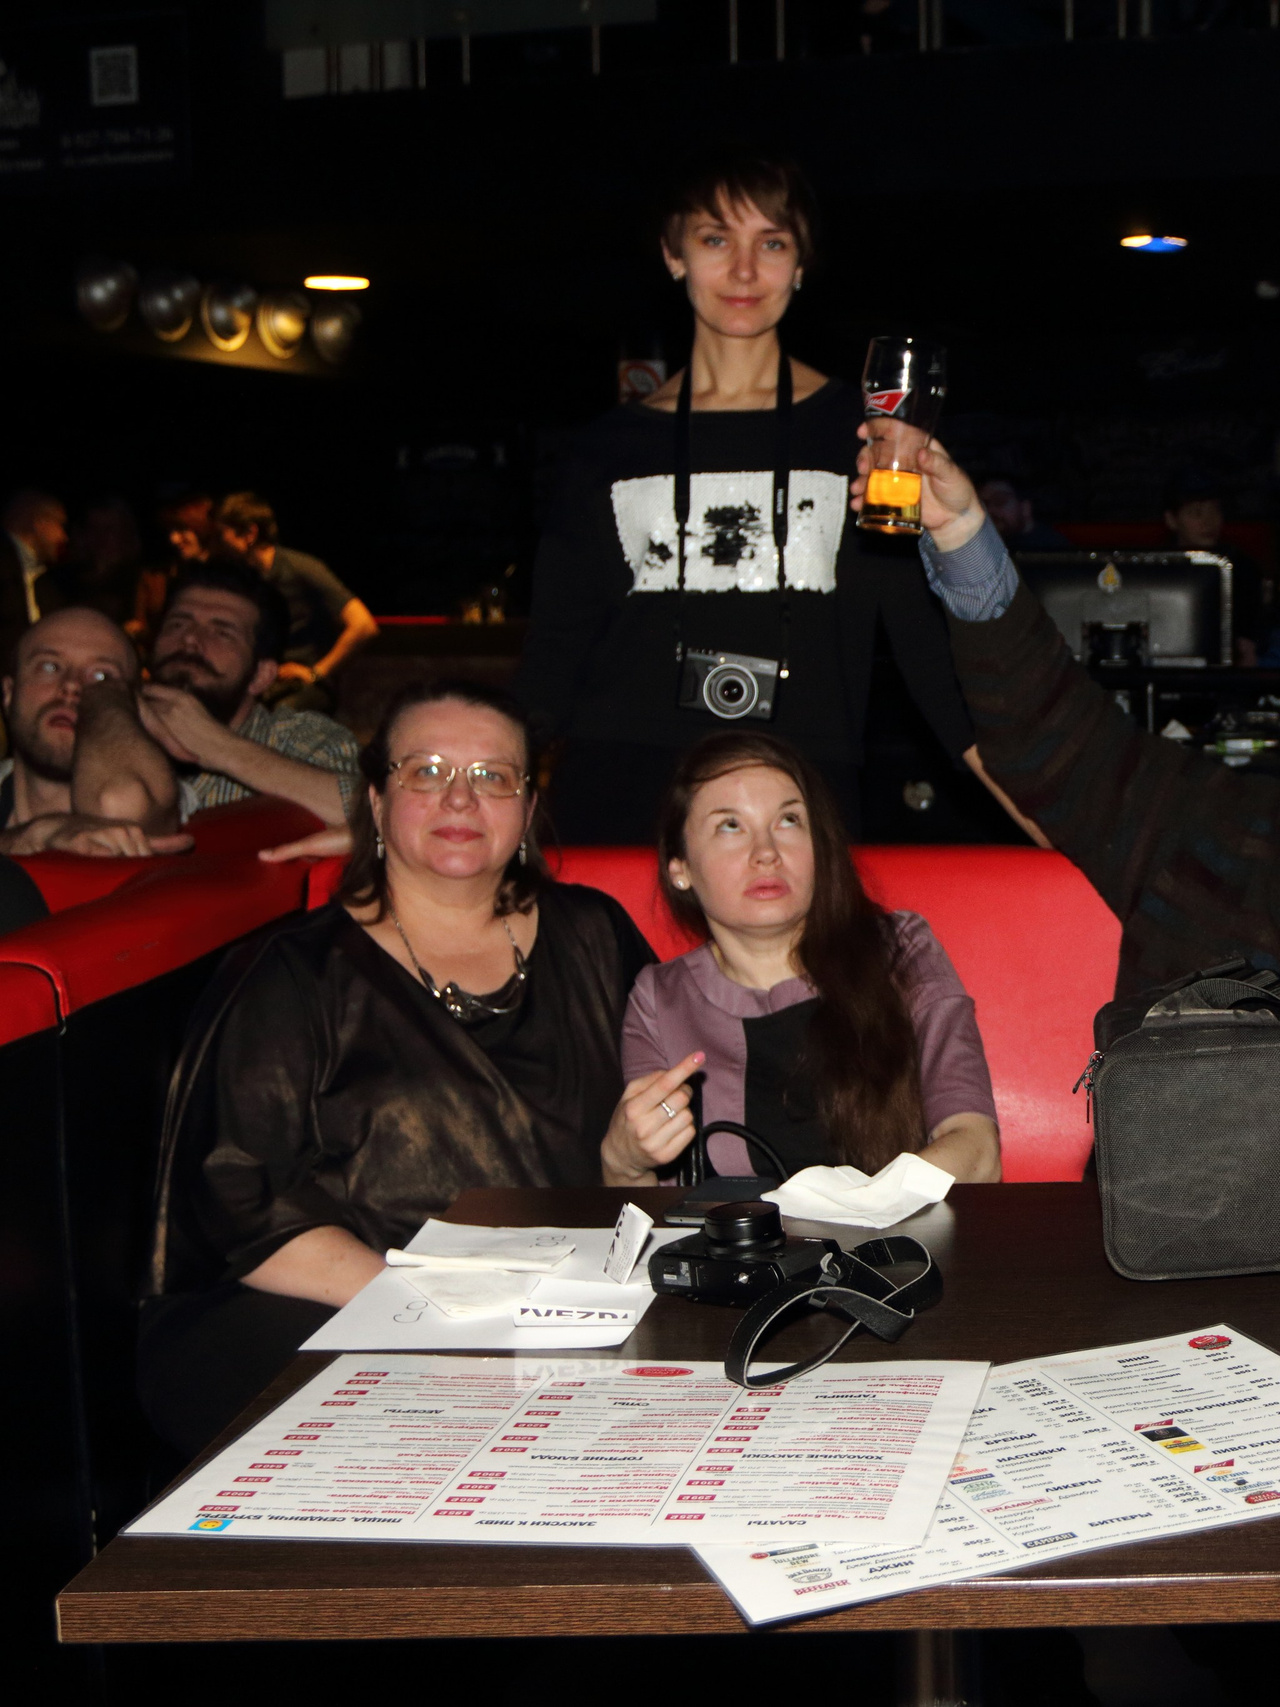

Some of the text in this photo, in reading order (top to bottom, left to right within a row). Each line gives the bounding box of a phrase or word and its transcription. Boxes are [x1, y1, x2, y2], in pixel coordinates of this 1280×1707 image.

[1117, 1355, 1150, 1365] ВИНО
[1171, 1386, 1195, 1394] Чили
[972, 1406, 997, 1415] ДКА
[1159, 1406, 1194, 1417] ПИВО
[1195, 1395, 1262, 1411] БОЧКОВОЕ
[984, 1432, 1038, 1446] БРЕНДИ
[1013, 1440, 1045, 1449] резерв
[996, 1446, 1067, 1463] НАСТОЙКИ
[1211, 1444, 1247, 1456] ПИВО
[1003, 1463, 1052, 1475] Бехеровка
[1011, 1473, 1045, 1482] Ксента
[1022, 1480, 1054, 1489] Антика
[1045, 1478, 1103, 1493] ЛИКЕРЫ
[986, 1498, 1048, 1513] DRAMBUIE
[994, 1509, 1034, 1520] Амарула
[1035, 1503, 1062, 1512] Крем
[195, 1513, 263, 1521] БУРГЕРЫ
[999, 1515, 1035, 1526] Малибу
[1088, 1511, 1153, 1527] БИТТЕРЫ
[1005, 1522, 1035, 1532] Калуа
[1012, 1524, 1052, 1537] Куантро
[1025, 1532, 1075, 1548] CAMPARI
[772, 1552, 821, 1565] TULLAMORE
[846, 1560, 871, 1570] Джек
[868, 1560, 915, 1574] ДЖИН
[859, 1569, 911, 1583] Биффитер
[793, 1579, 851, 1596] BEEFEATER
